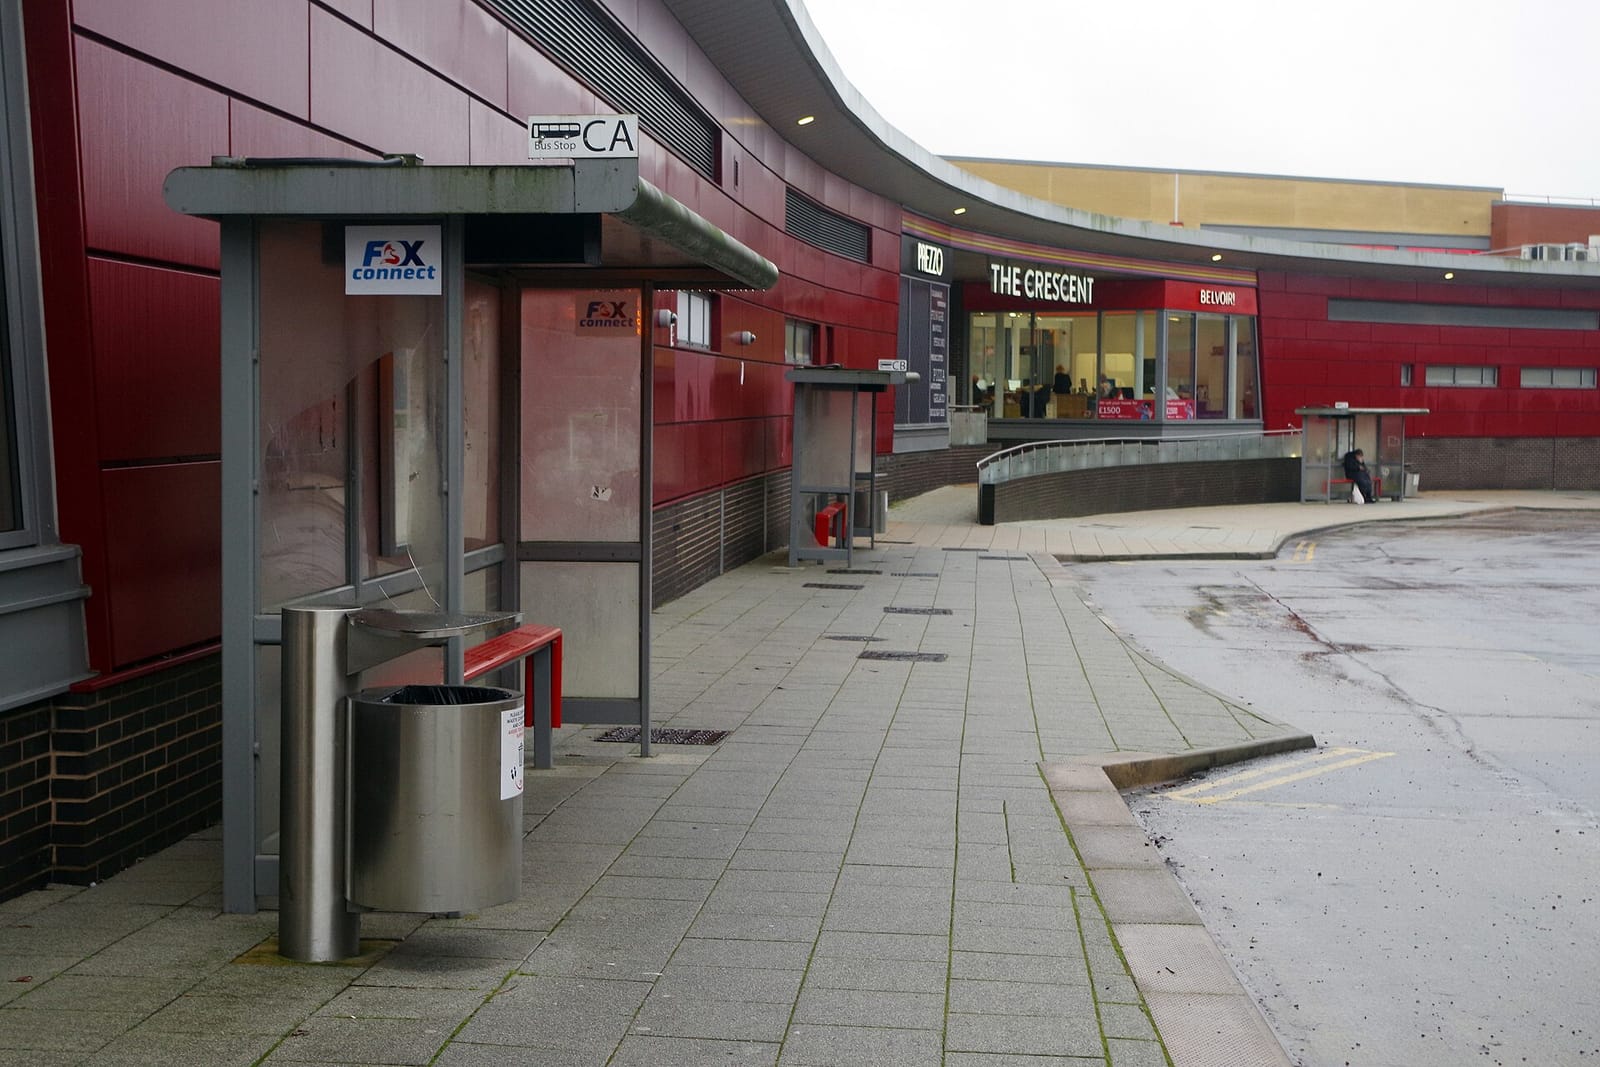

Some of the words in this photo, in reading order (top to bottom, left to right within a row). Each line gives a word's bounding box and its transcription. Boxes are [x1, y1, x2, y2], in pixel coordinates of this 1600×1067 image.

[583, 120, 634, 152] CA
[534, 141, 552, 150] Bus
[553, 140, 576, 151] Stop
[917, 242, 944, 276] PREZZO
[352, 265, 436, 281] connect
[991, 263, 1021, 297] THE
[1024, 269, 1094, 304] CRESCENT
[1200, 289, 1235, 306] BELVOIR!
[579, 318, 634, 328] connect
[892, 360, 906, 371] CB
[1098, 406, 1121, 415] £1500
